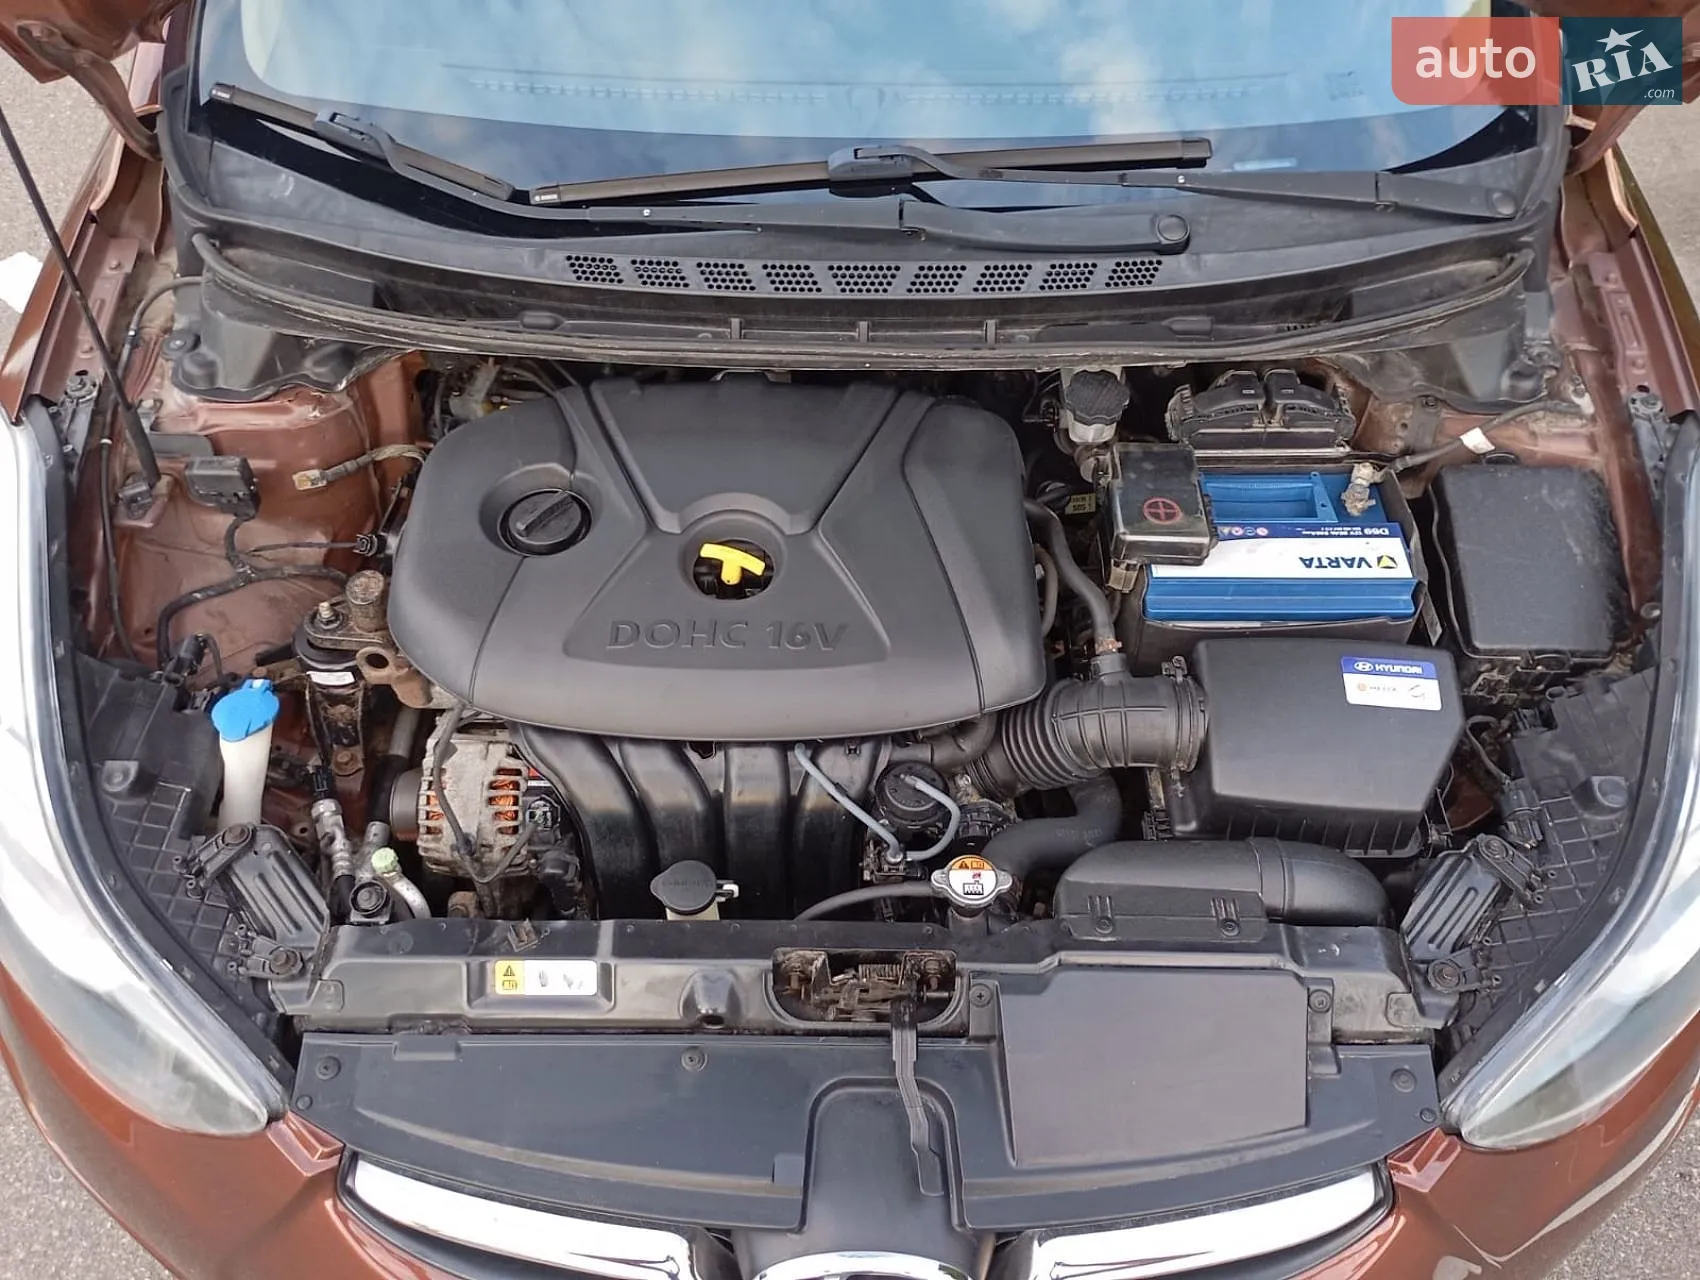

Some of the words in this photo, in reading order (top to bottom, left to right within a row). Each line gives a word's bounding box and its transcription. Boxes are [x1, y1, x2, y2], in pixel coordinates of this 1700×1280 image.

[1298, 556, 1373, 569] VARTA
[606, 620, 749, 650] DOHC
[765, 620, 848, 651] 16V
[1375, 663, 1423, 675] HYUNDAI
